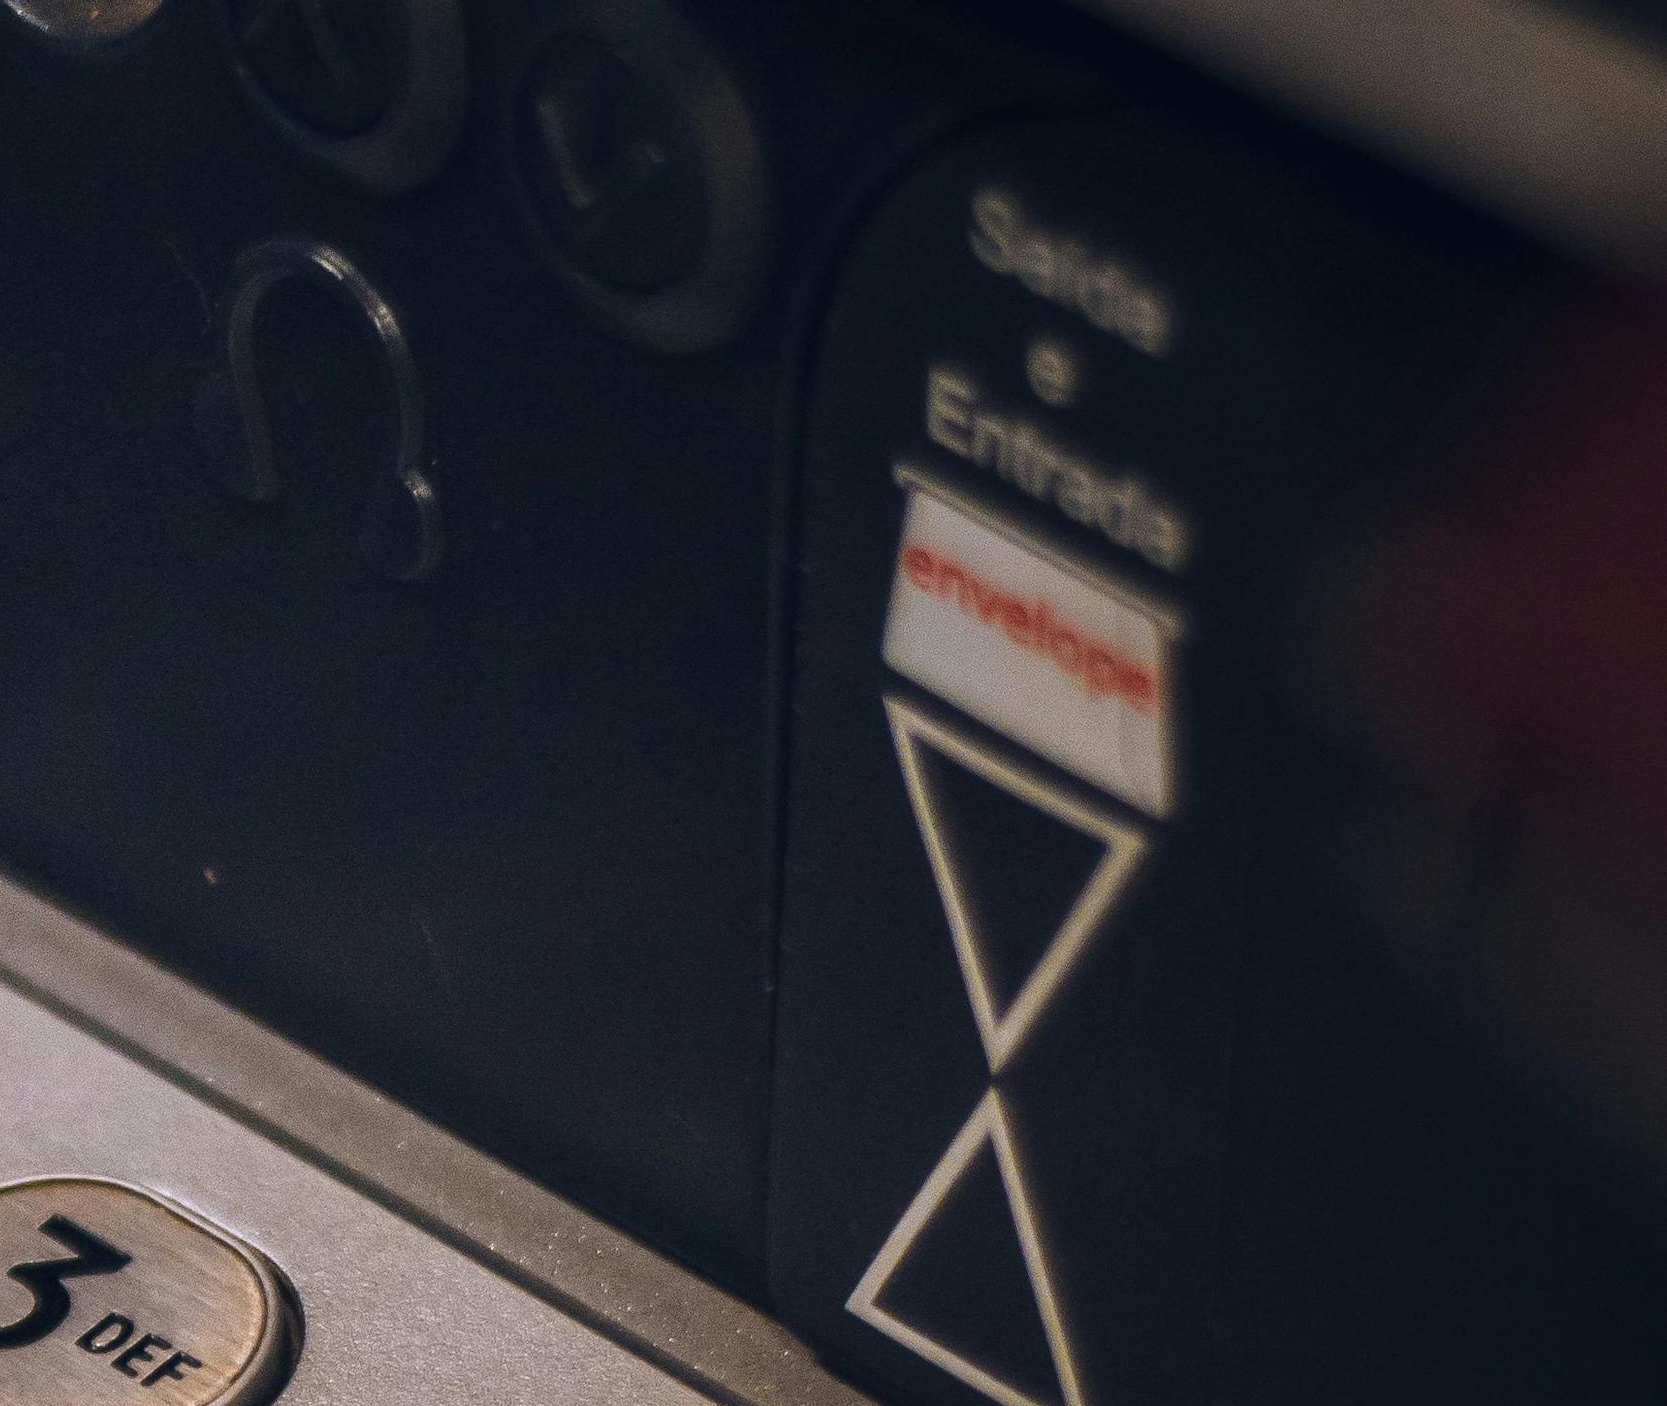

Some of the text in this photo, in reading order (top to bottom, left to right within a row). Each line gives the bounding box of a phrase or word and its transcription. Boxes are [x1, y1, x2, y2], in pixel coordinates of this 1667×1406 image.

[1027, 336, 1079, 407] e
[927, 366, 1191, 572] Entrada
[903, 544, 1158, 717] envelope
[75, 1311, 203, 1387] DEF
